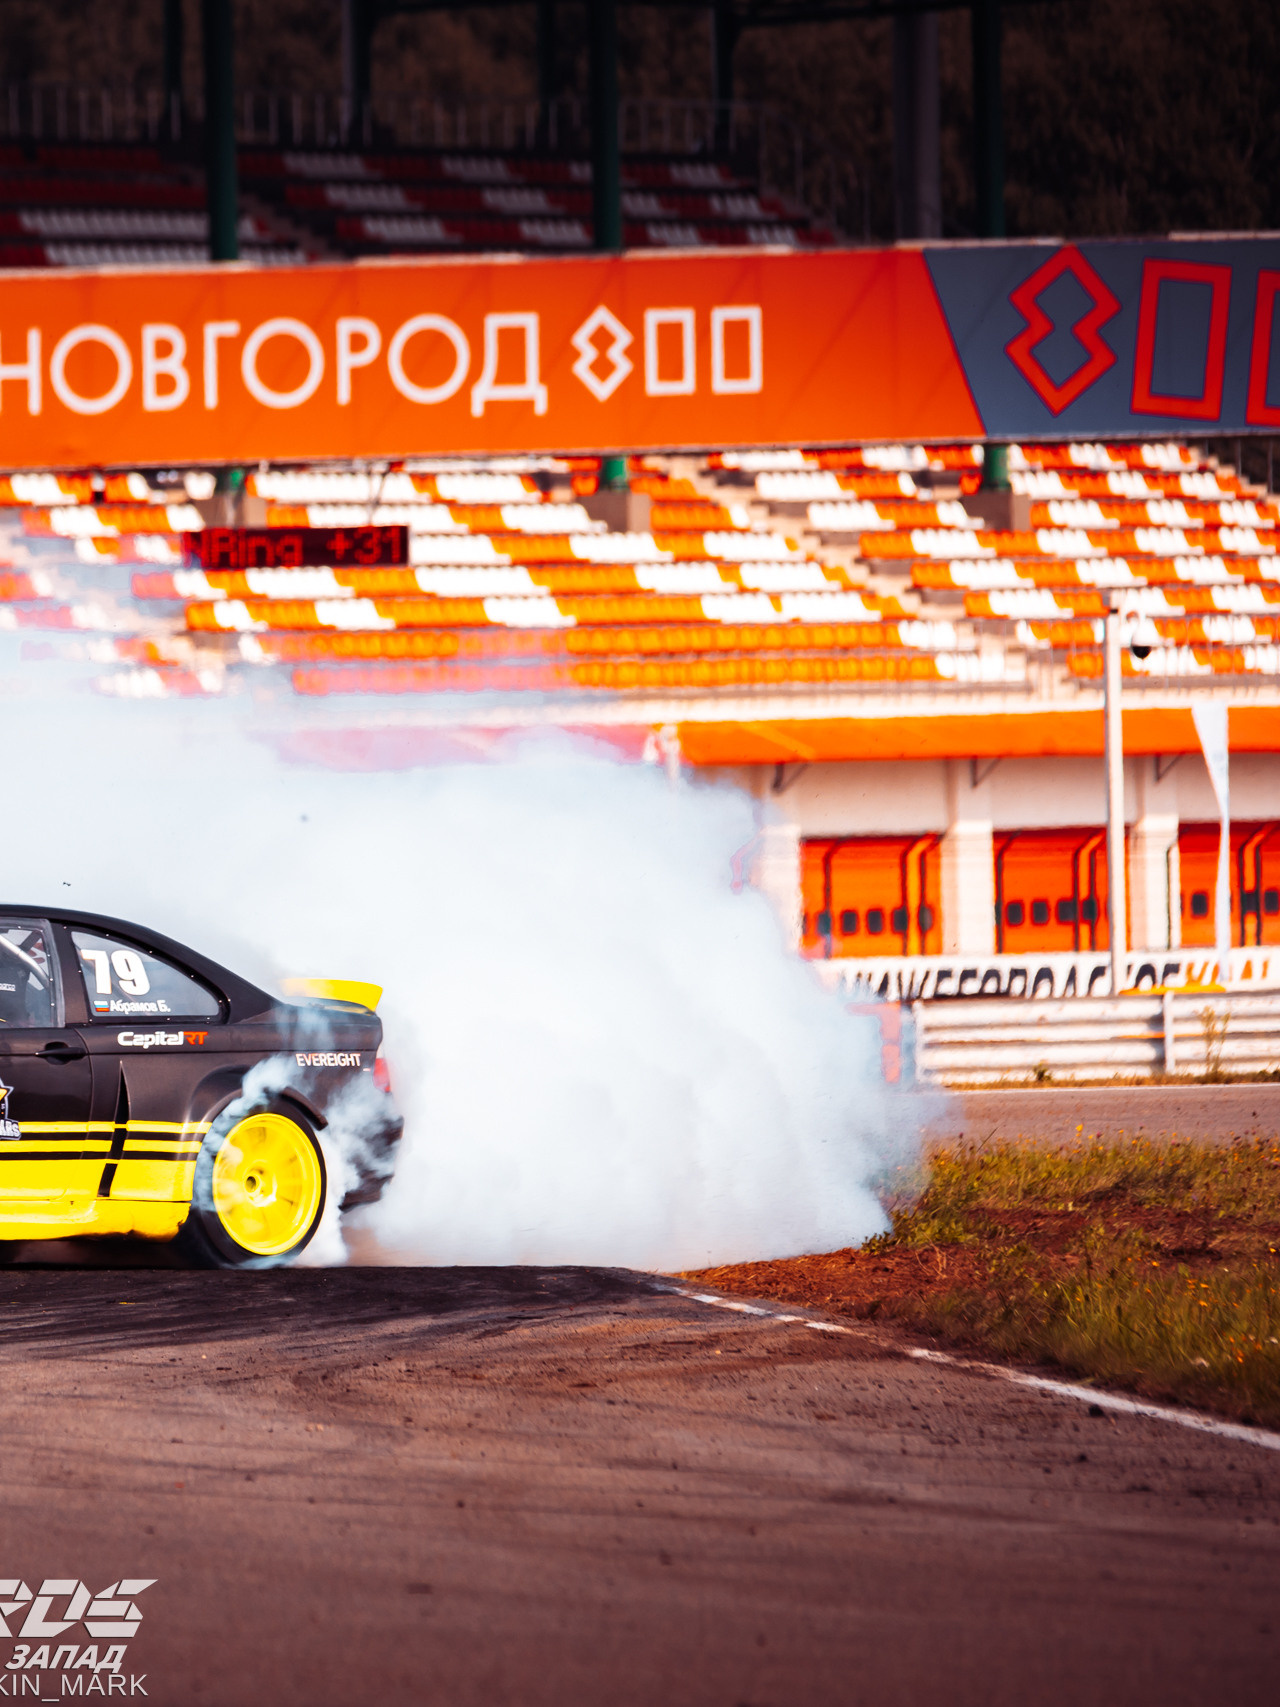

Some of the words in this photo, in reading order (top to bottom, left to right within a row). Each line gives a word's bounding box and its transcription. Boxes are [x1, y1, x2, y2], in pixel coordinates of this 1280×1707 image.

[326, 525, 402, 564] +31
[80, 949, 151, 996] 79
[110, 1000, 158, 1015] Абрамов
[156, 1000, 171, 1013] Б.
[295, 1052, 361, 1067] EVEREIGHT
